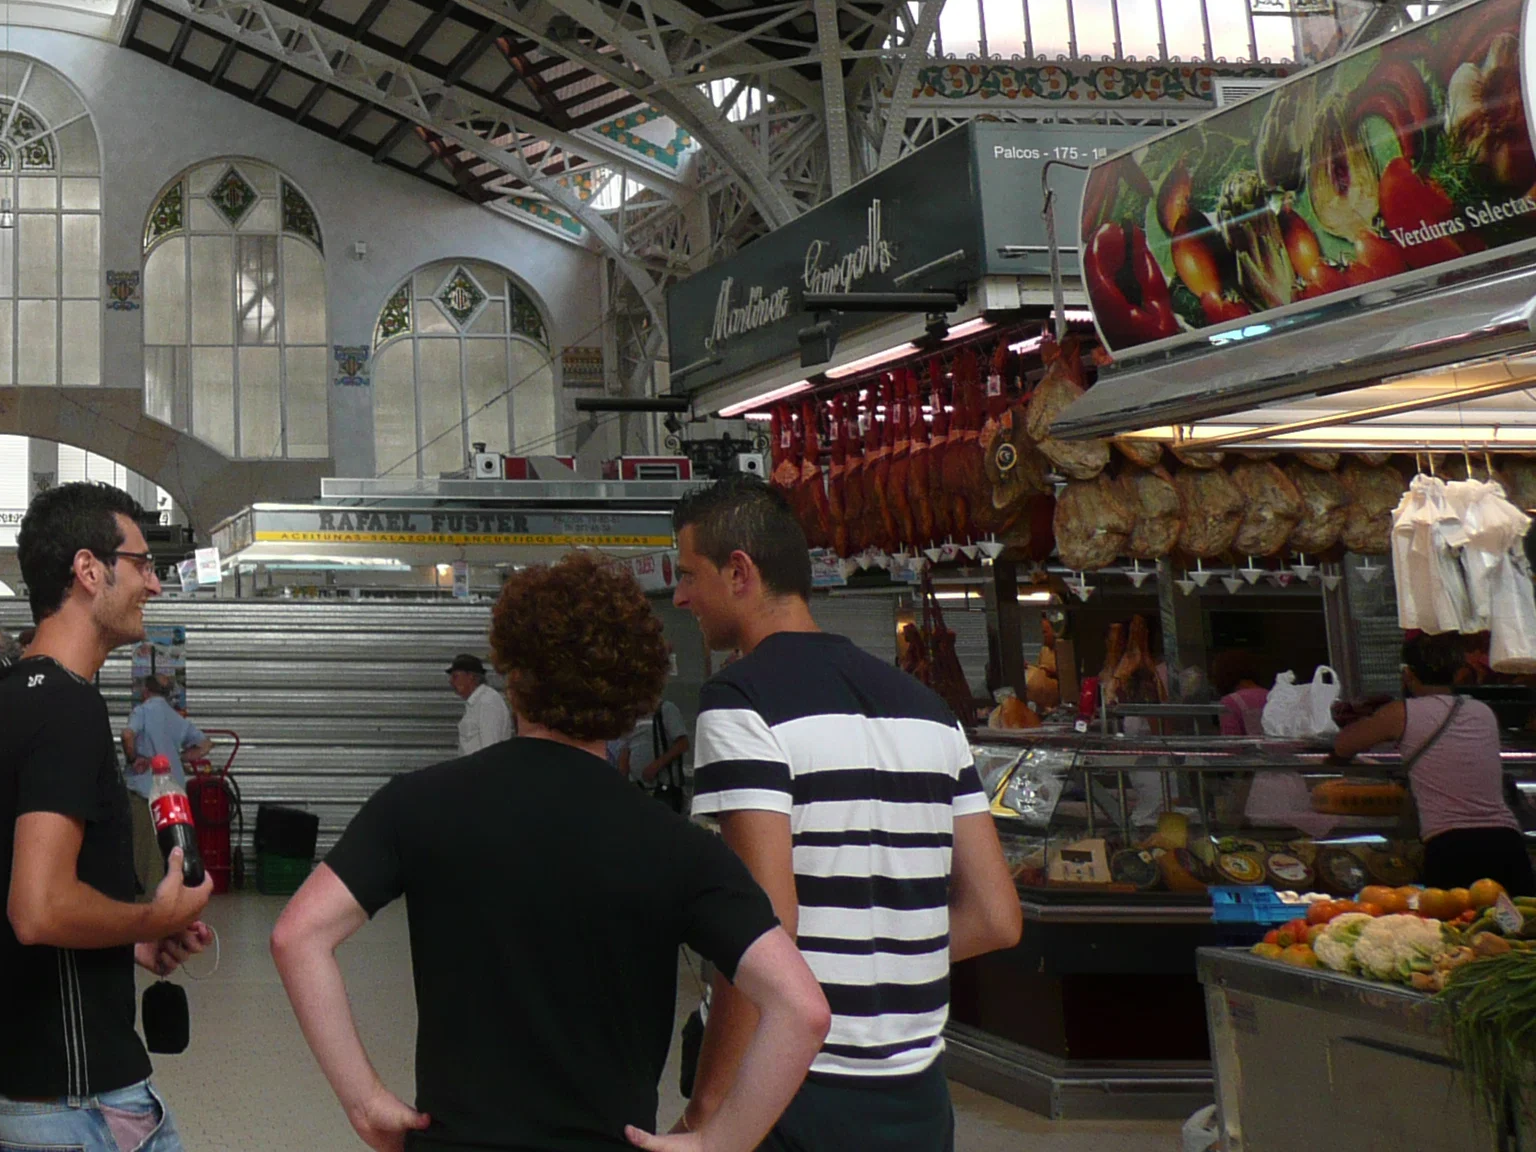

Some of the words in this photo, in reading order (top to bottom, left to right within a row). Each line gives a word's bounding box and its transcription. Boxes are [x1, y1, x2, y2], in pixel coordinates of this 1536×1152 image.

[993, 145, 1041, 159] Palcos
[1053, 146, 1079, 160] 175
[1390, 215, 1466, 249] Verduras
[1465, 194, 1536, 228] Selectas
[318, 511, 417, 532] RAFAEL
[430, 512, 530, 534] FUSTER
